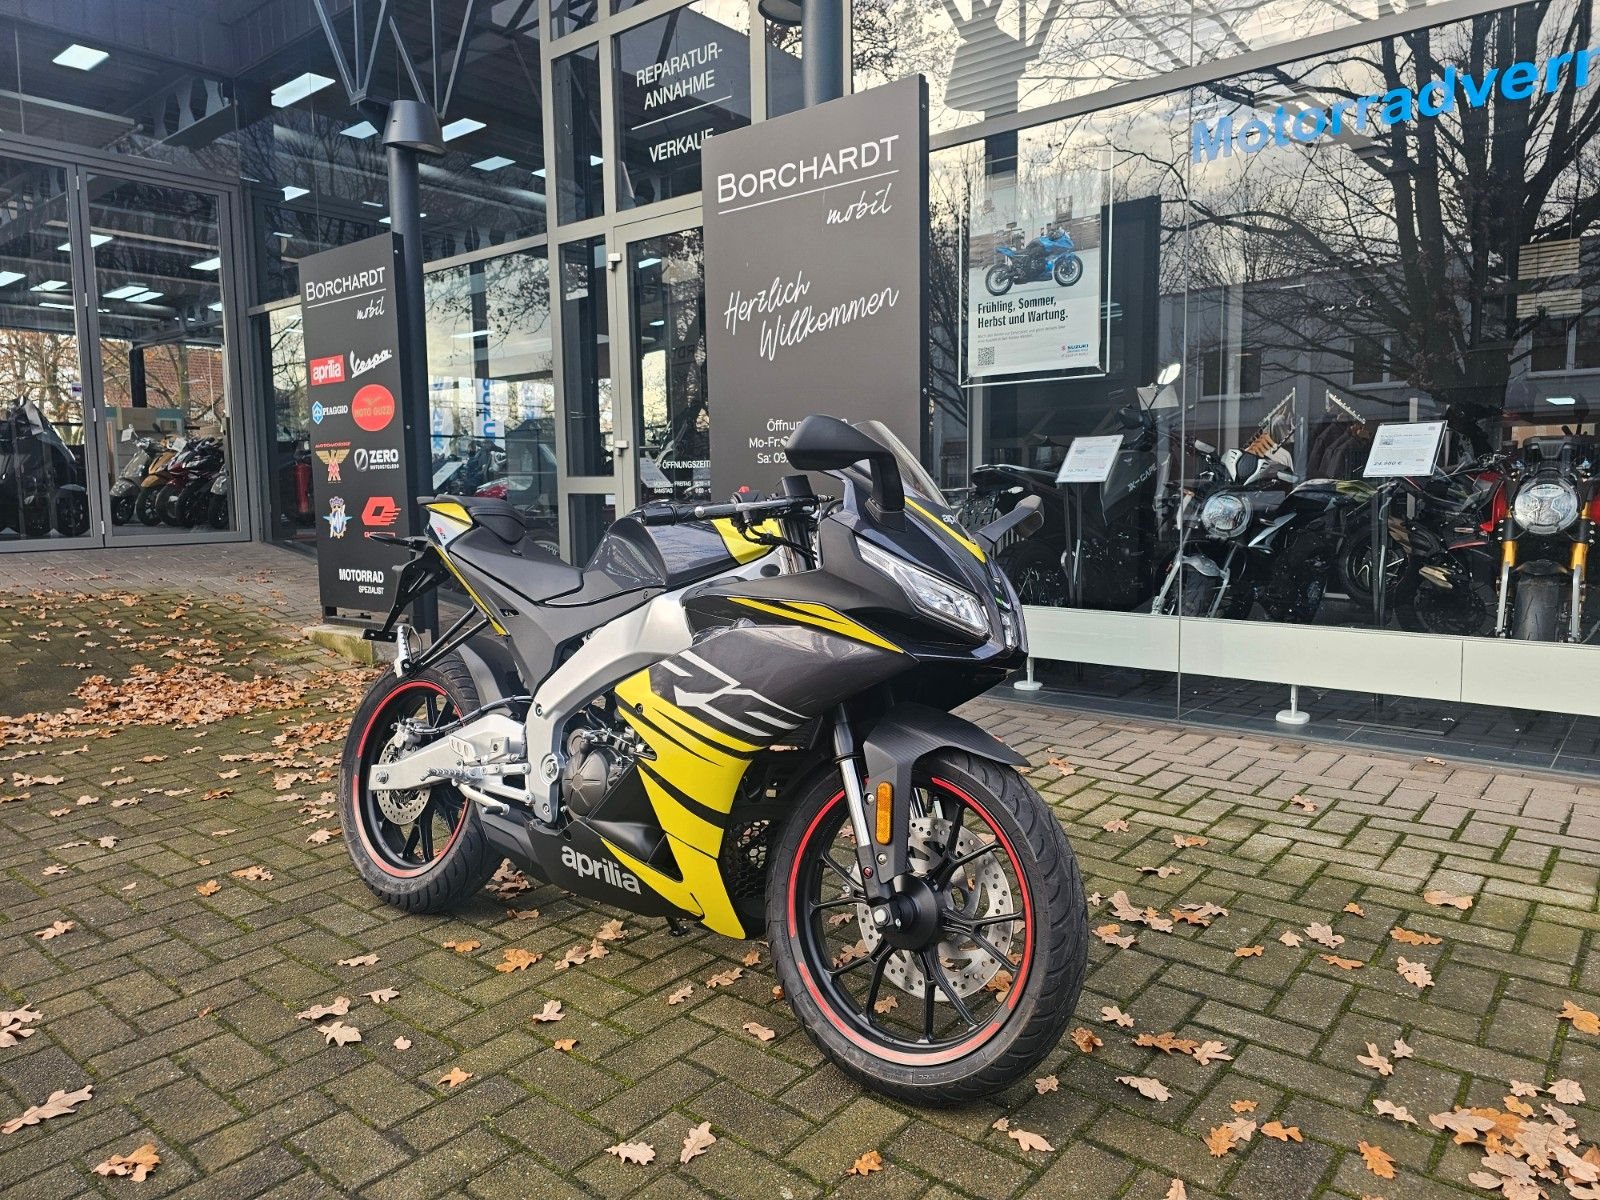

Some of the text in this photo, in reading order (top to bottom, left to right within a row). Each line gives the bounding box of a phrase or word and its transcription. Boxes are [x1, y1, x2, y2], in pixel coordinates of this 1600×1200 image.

[636, 42, 723, 87] REPARATUR-
[644, 69, 715, 110] ANNAHME
[717, 135, 899, 204] BORCHARDT
[826, 182, 892, 225] mobil
[305, 267, 386, 302] BORCHARDT
[356, 296, 385, 320] mobil
[724, 270, 811, 336] Herzlich
[978, 296, 1057, 314] Frühling, Sommer,
[759, 287, 899, 361] Willkommen
[977, 308, 1069, 329] Herbst und Wartung.
[312, 360, 342, 383] aprilia
[349, 350, 393, 378] Vespa
[323, 405, 349, 416] PIAGGIO
[368, 448, 399, 464] ZERO
[757, 453, 772, 464] Sa:
[338, 568, 385, 583] MOTORRAD
[358, 585, 385, 595] SPEZIALIST
[561, 845, 642, 895] aprilia
